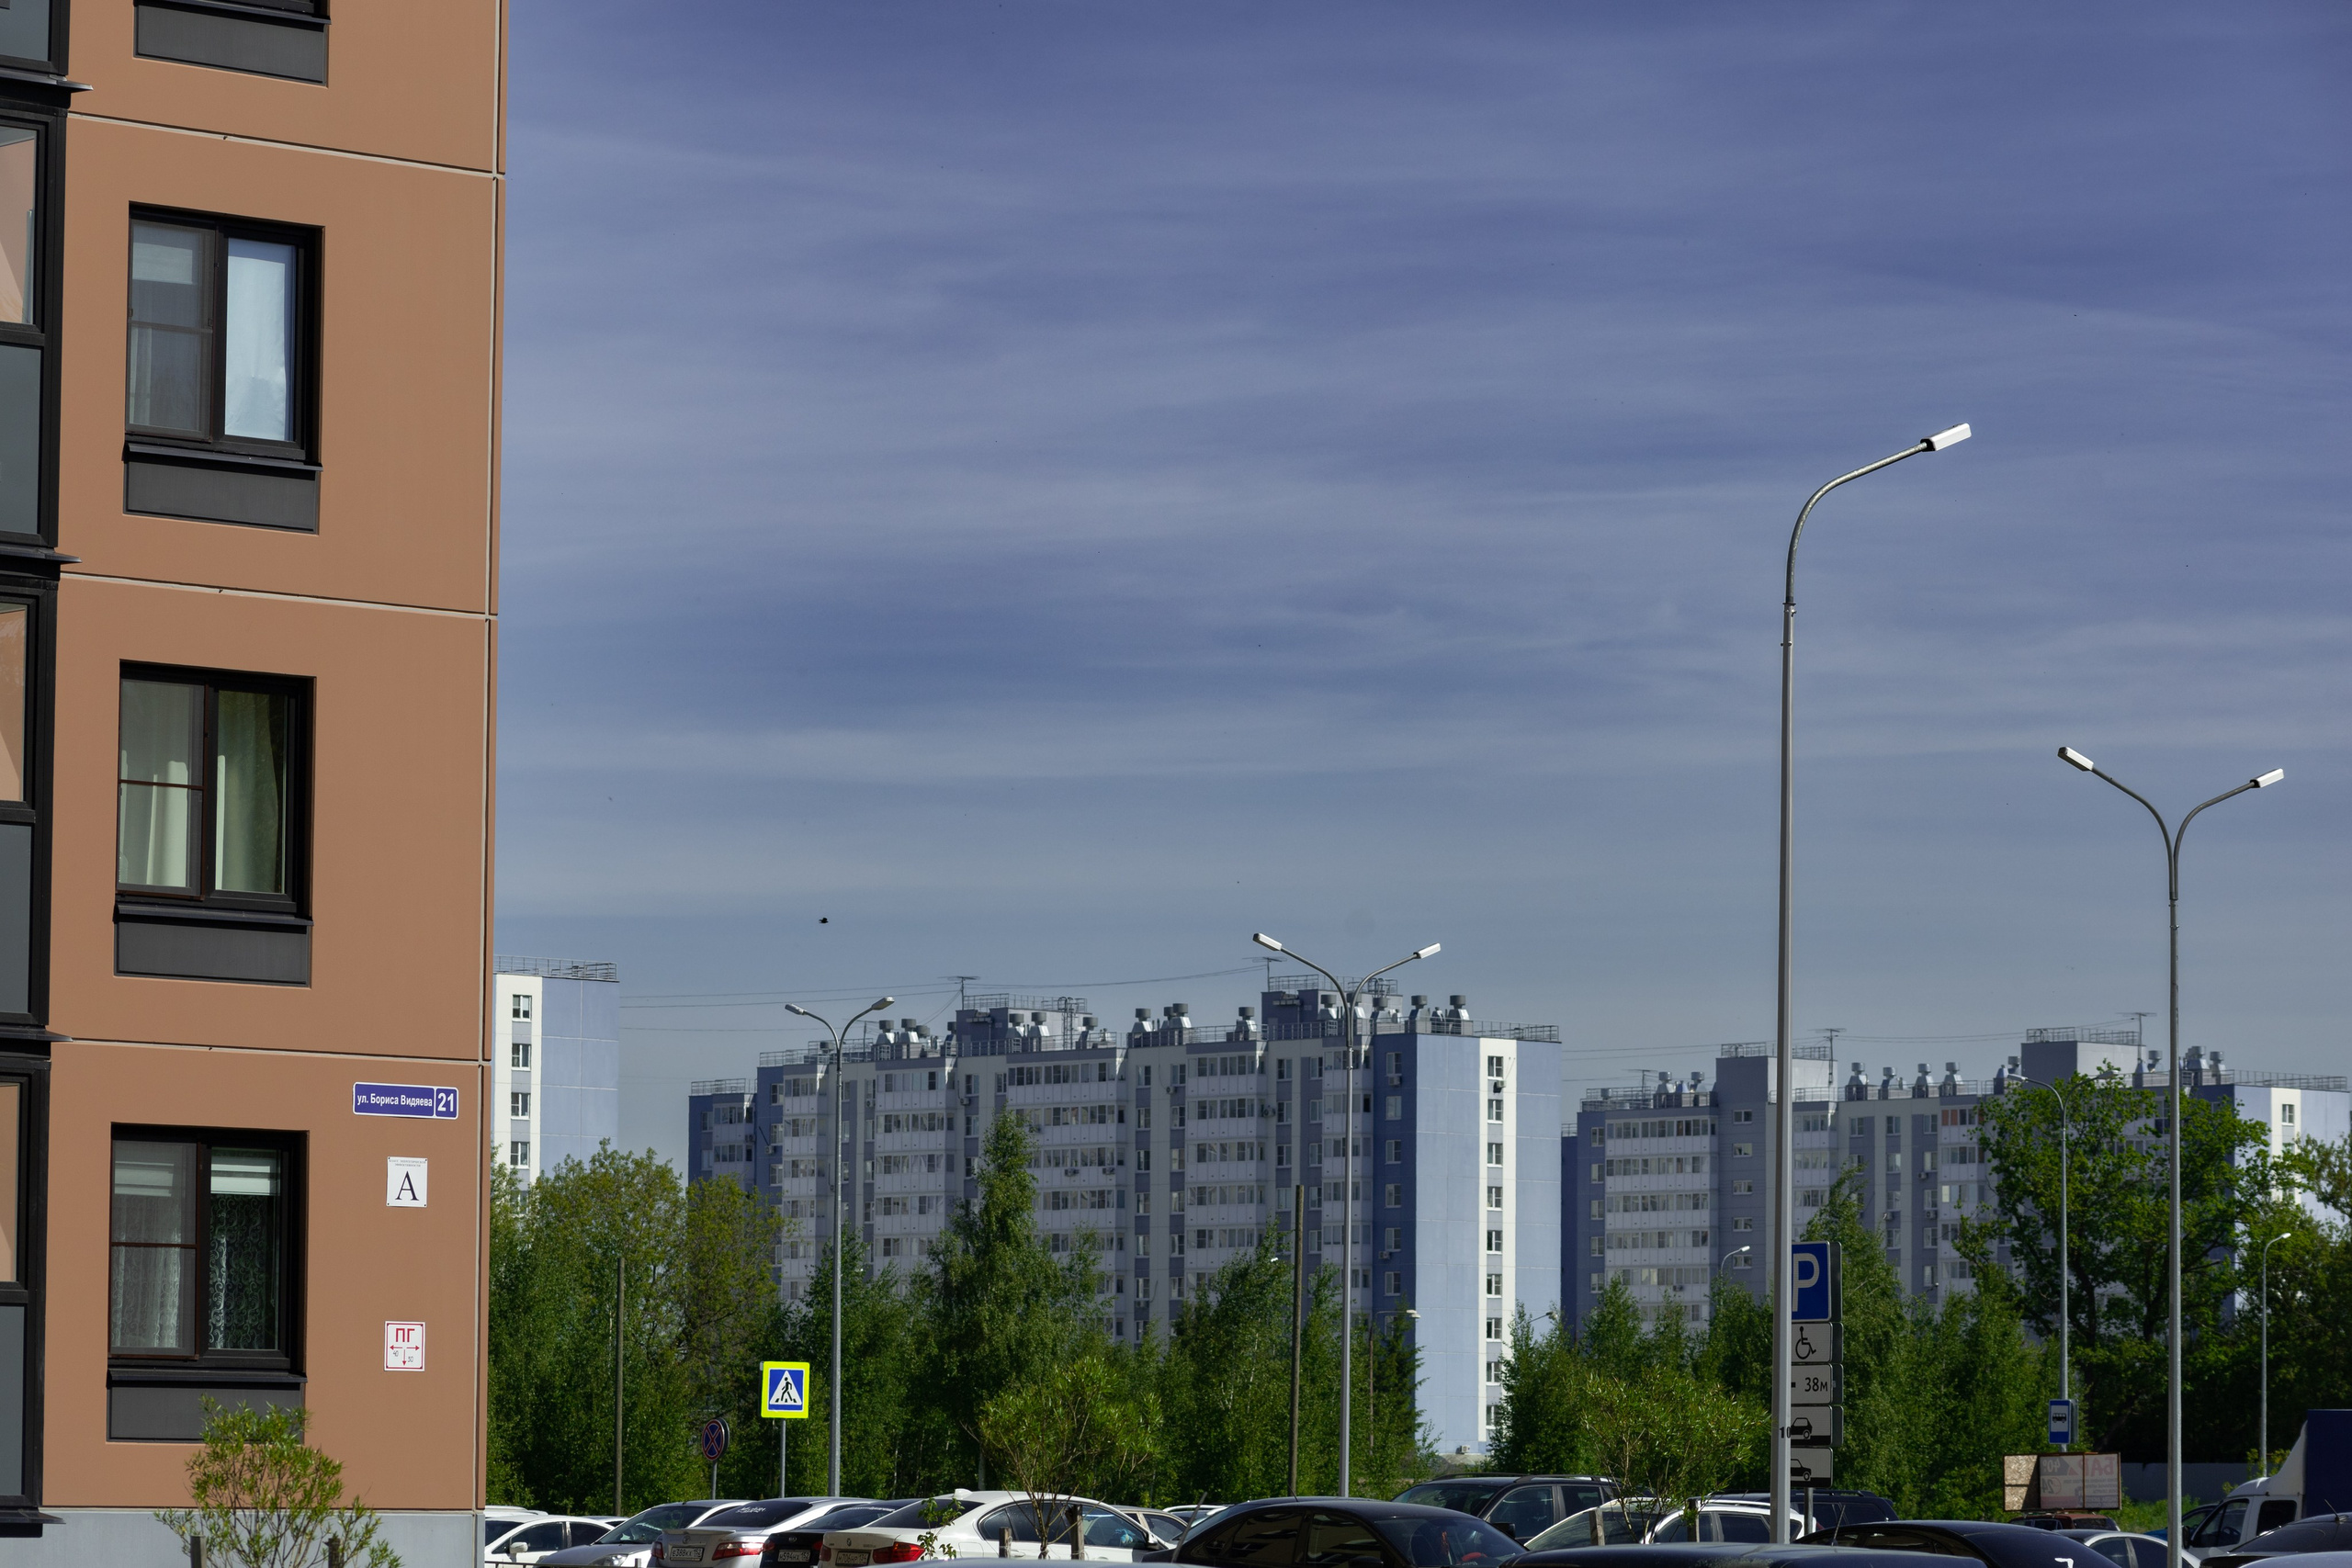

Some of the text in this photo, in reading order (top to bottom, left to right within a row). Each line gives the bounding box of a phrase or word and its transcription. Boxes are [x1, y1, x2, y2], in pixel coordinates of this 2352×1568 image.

[357, 1093, 433, 1107] ул. Бориса Видяева
[437, 1092, 454, 1111] 21
[1792, 1253, 1820, 1312] P
[396, 1328, 414, 1342] ПГ
[1780, 1426, 1792, 1438] 10
